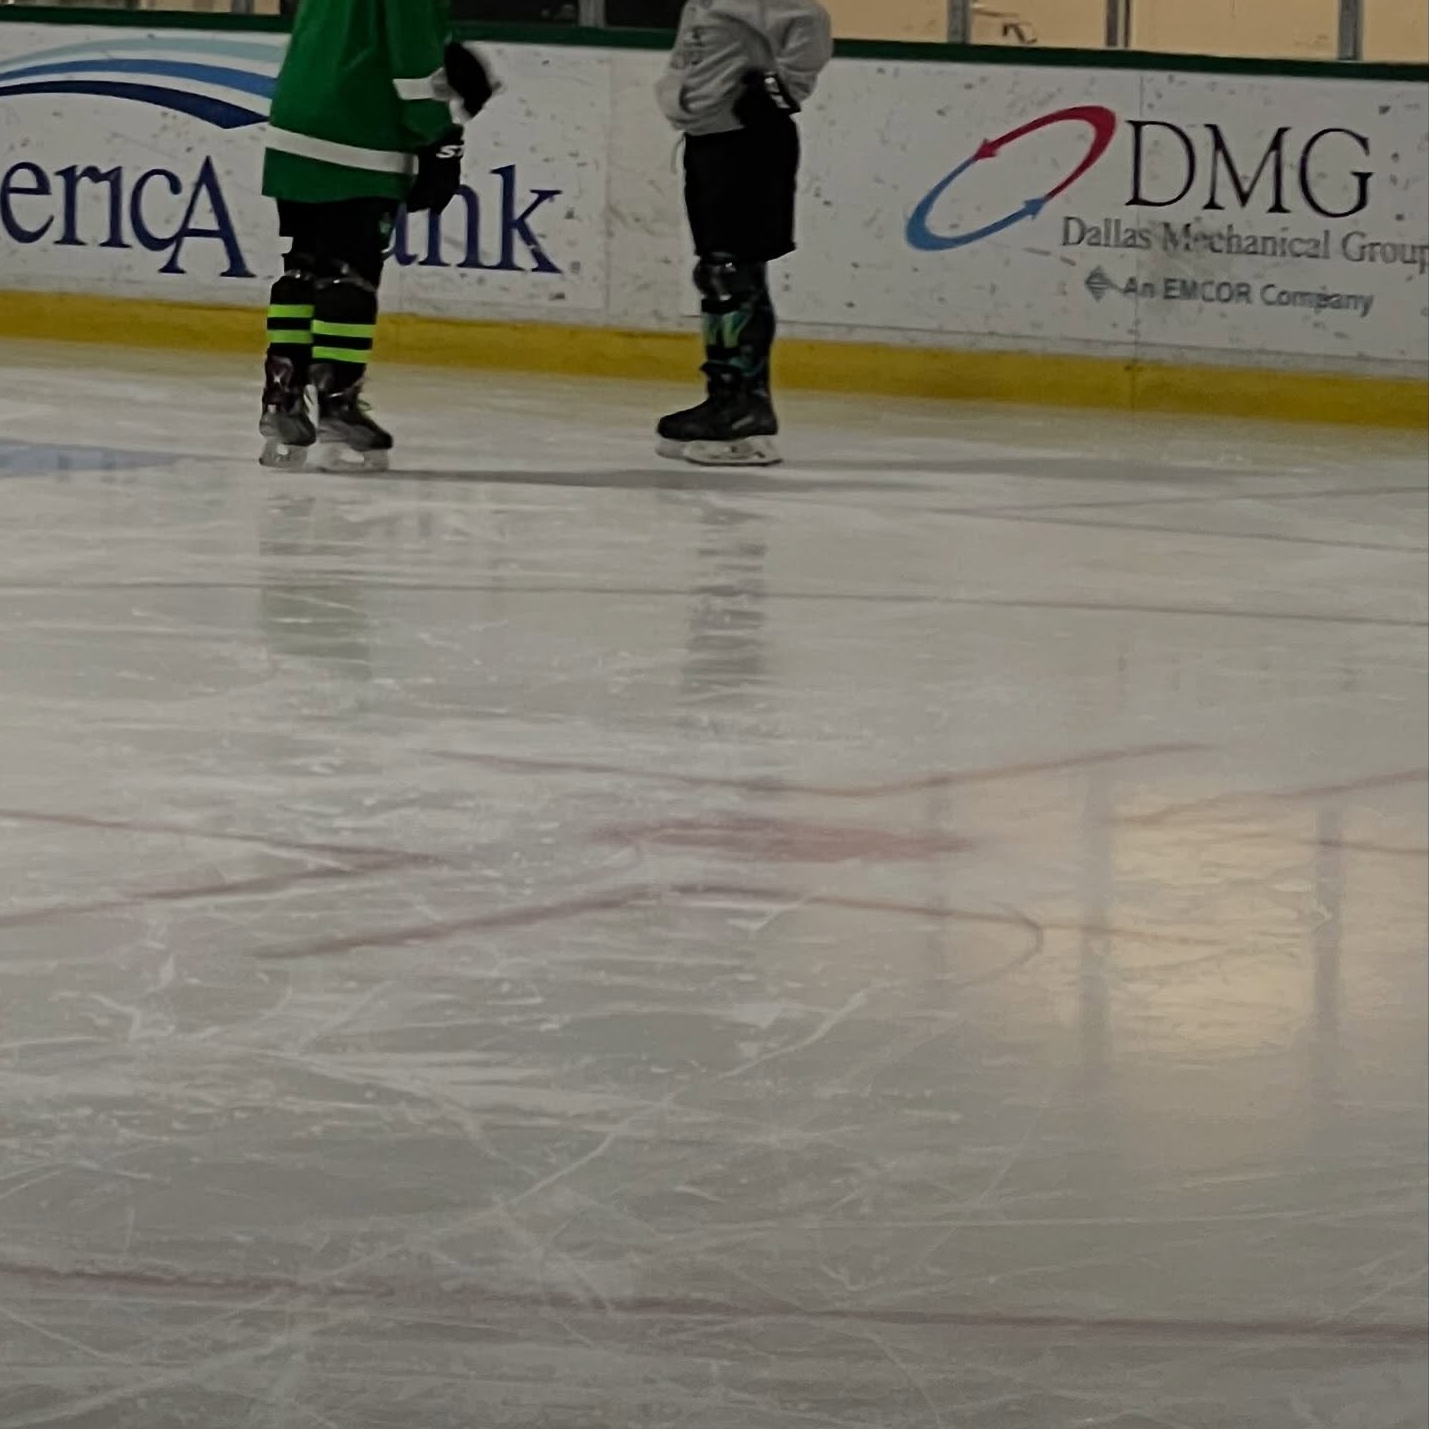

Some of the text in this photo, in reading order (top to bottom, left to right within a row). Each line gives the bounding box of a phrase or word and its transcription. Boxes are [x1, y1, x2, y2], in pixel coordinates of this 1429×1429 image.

[1124, 118, 1374, 220] DMG
[381, 163, 564, 274] ank
[1061, 216, 1152, 252] Dallas
[1123, 276, 1375, 317] An EMCOR Company
